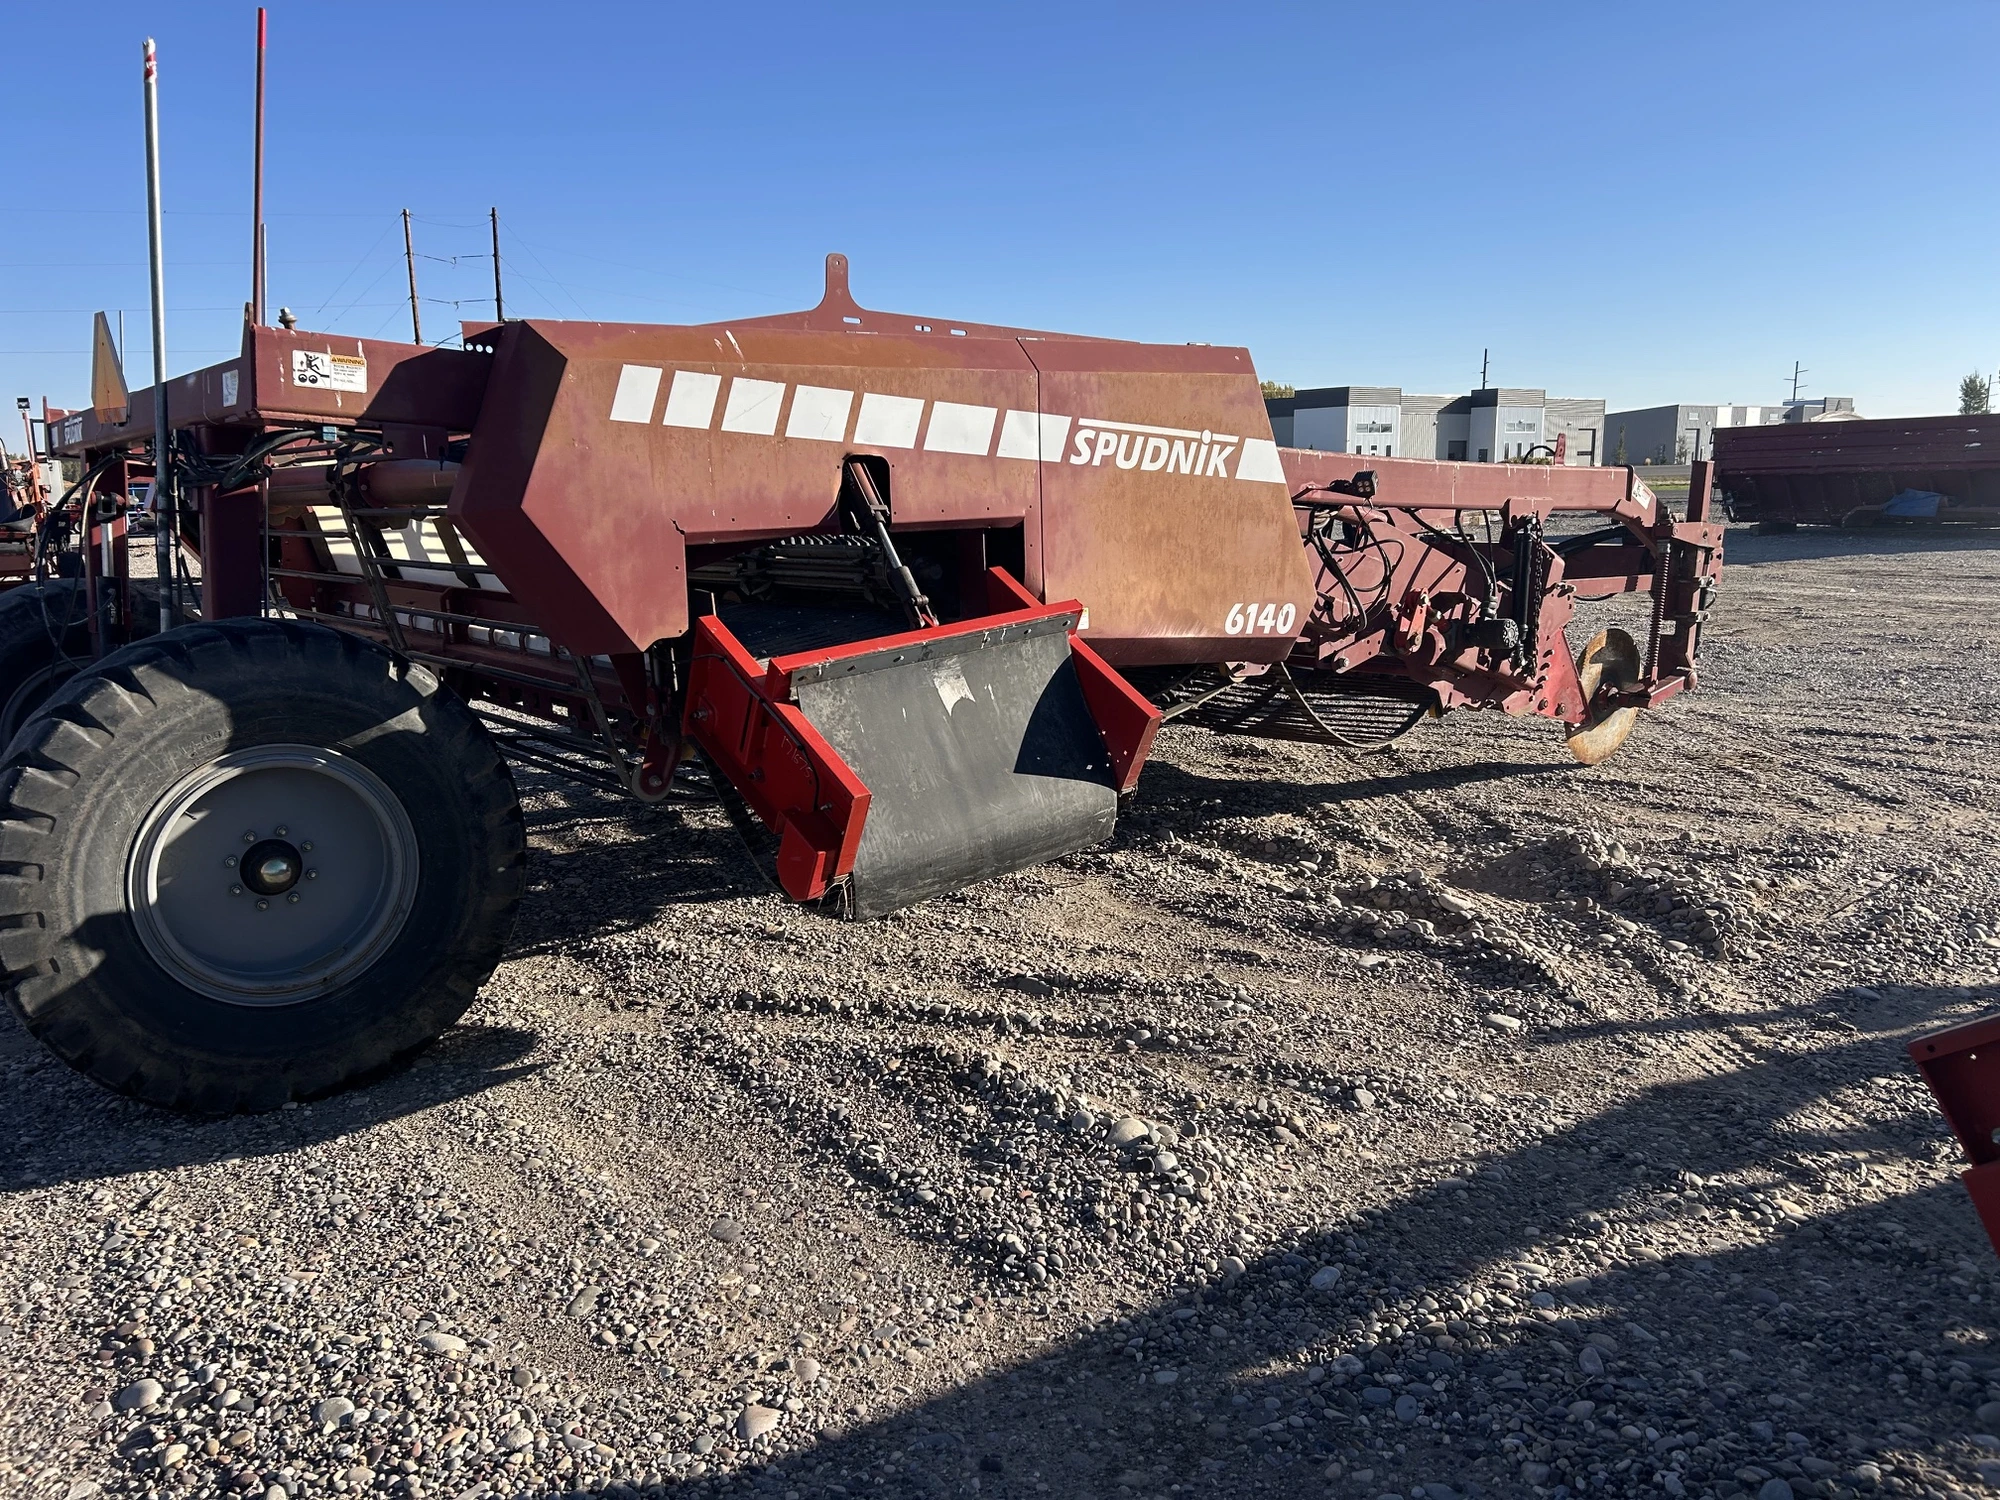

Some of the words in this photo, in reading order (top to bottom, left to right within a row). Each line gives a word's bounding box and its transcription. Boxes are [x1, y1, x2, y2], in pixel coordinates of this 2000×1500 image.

[338, 358, 365, 366] WARNING
[1069, 429, 1236, 478] SPUDNIK
[1225, 603, 1296, 635] 6140
